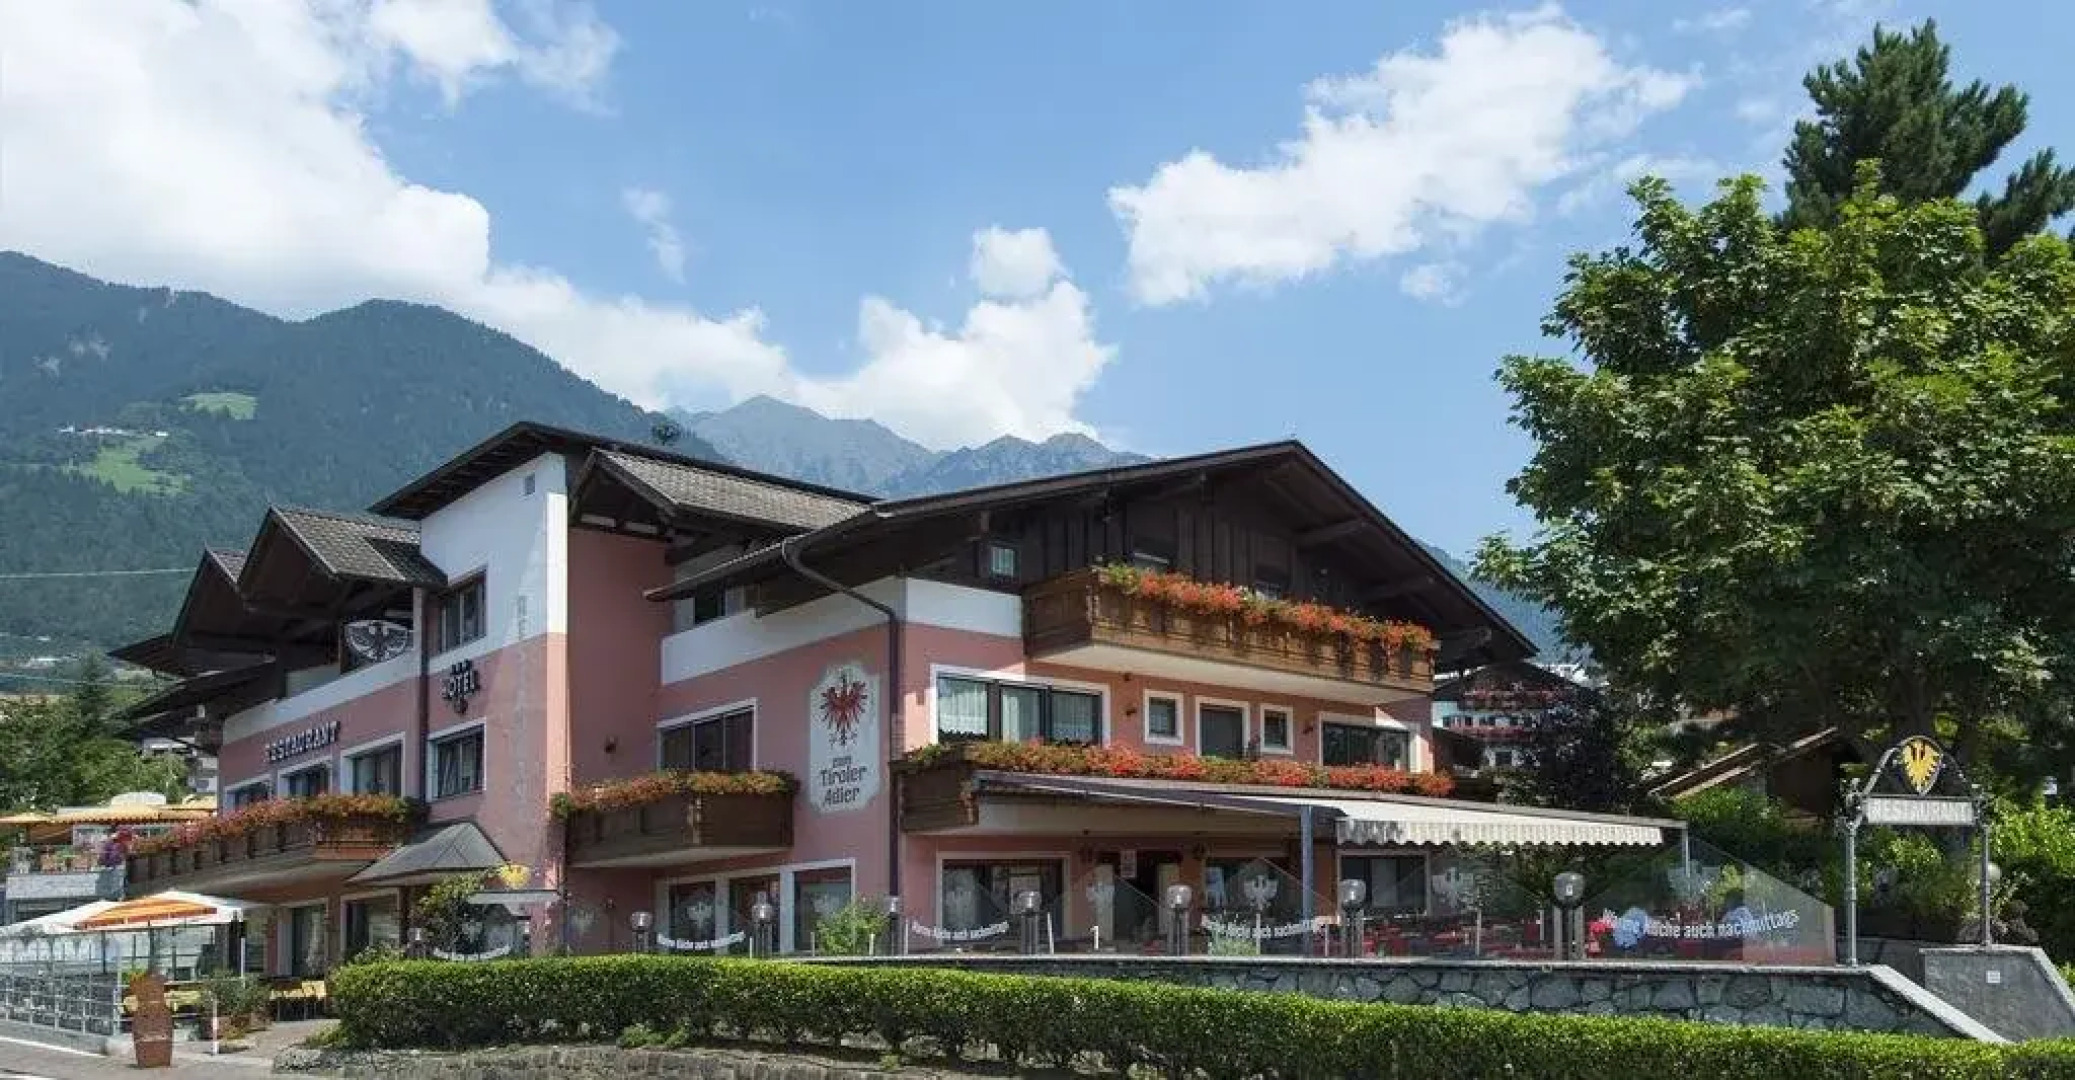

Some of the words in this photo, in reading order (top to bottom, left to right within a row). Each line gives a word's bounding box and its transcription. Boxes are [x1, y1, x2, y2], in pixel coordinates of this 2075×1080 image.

[820, 765, 868, 787] Tiroler
[822, 787, 861, 807] Adler
[1869, 800, 1973, 822] RESTAURANT
[1683, 920, 1715, 938] auch
[1717, 908, 1800, 937] nachmittags
